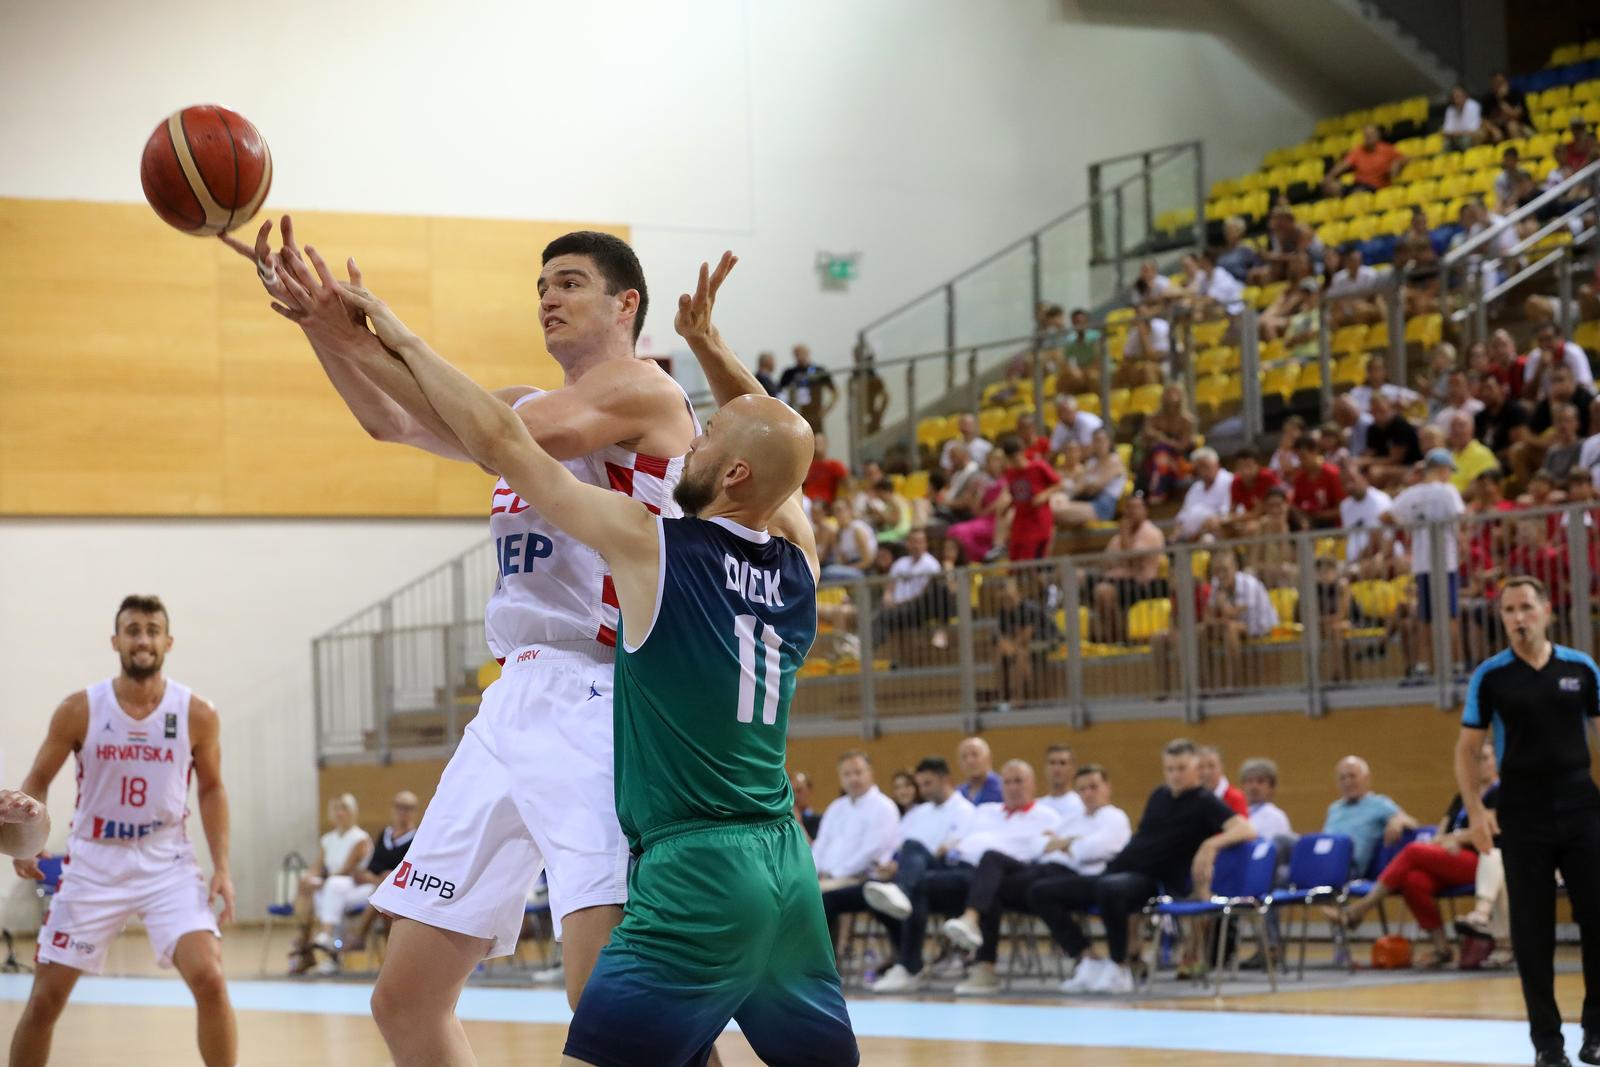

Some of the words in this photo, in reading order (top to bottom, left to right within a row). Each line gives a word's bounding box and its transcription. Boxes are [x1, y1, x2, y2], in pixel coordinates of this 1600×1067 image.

[724, 553, 785, 607] DICK
[517, 649, 541, 663] HRV
[734, 614, 783, 725] 11
[96, 744, 174, 762] HRVATSKA
[121, 775, 147, 808] 18
[409, 870, 456, 900] HPB
